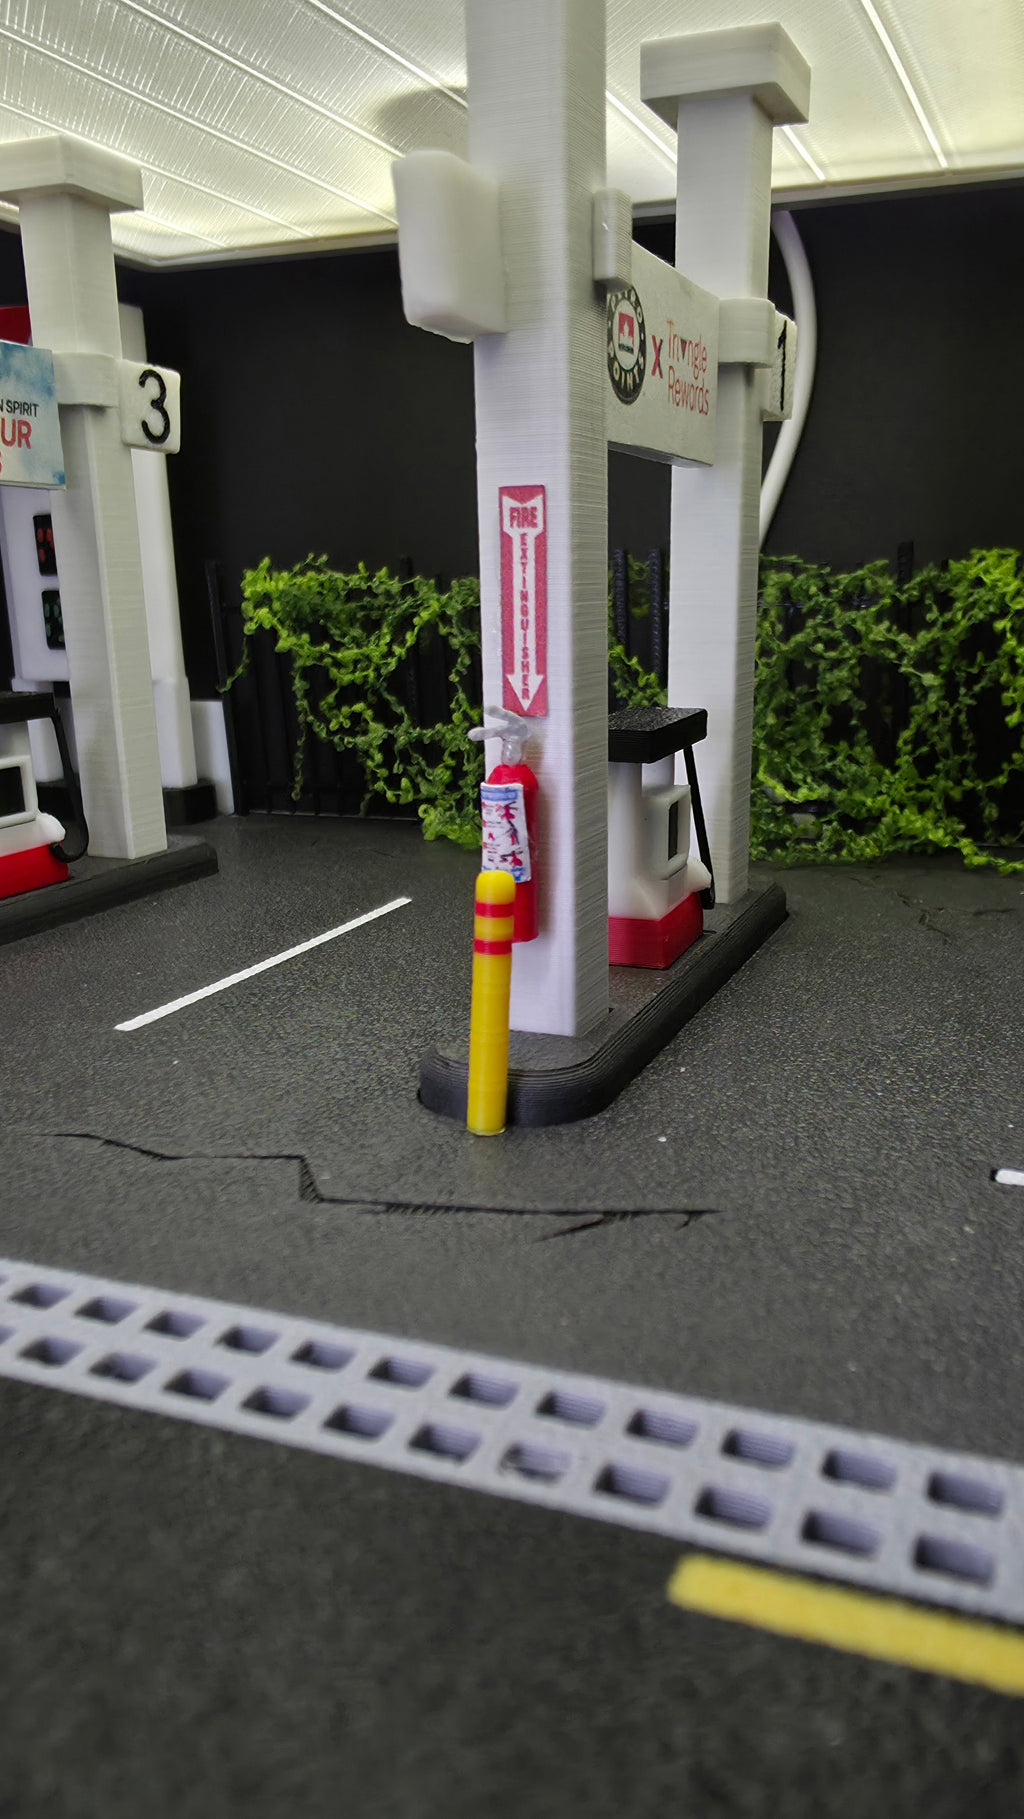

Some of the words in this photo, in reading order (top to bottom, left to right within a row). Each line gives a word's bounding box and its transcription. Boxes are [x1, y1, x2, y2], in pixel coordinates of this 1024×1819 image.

[668, 365, 710, 416] Rewards
[777, 320, 788, 412] 1
[6, 399, 39, 417] SPIRIT
[138, 369, 171, 444] 3
[509, 506, 538, 529] FIRE
[519, 532, 531, 700] EXTINGUISHER
